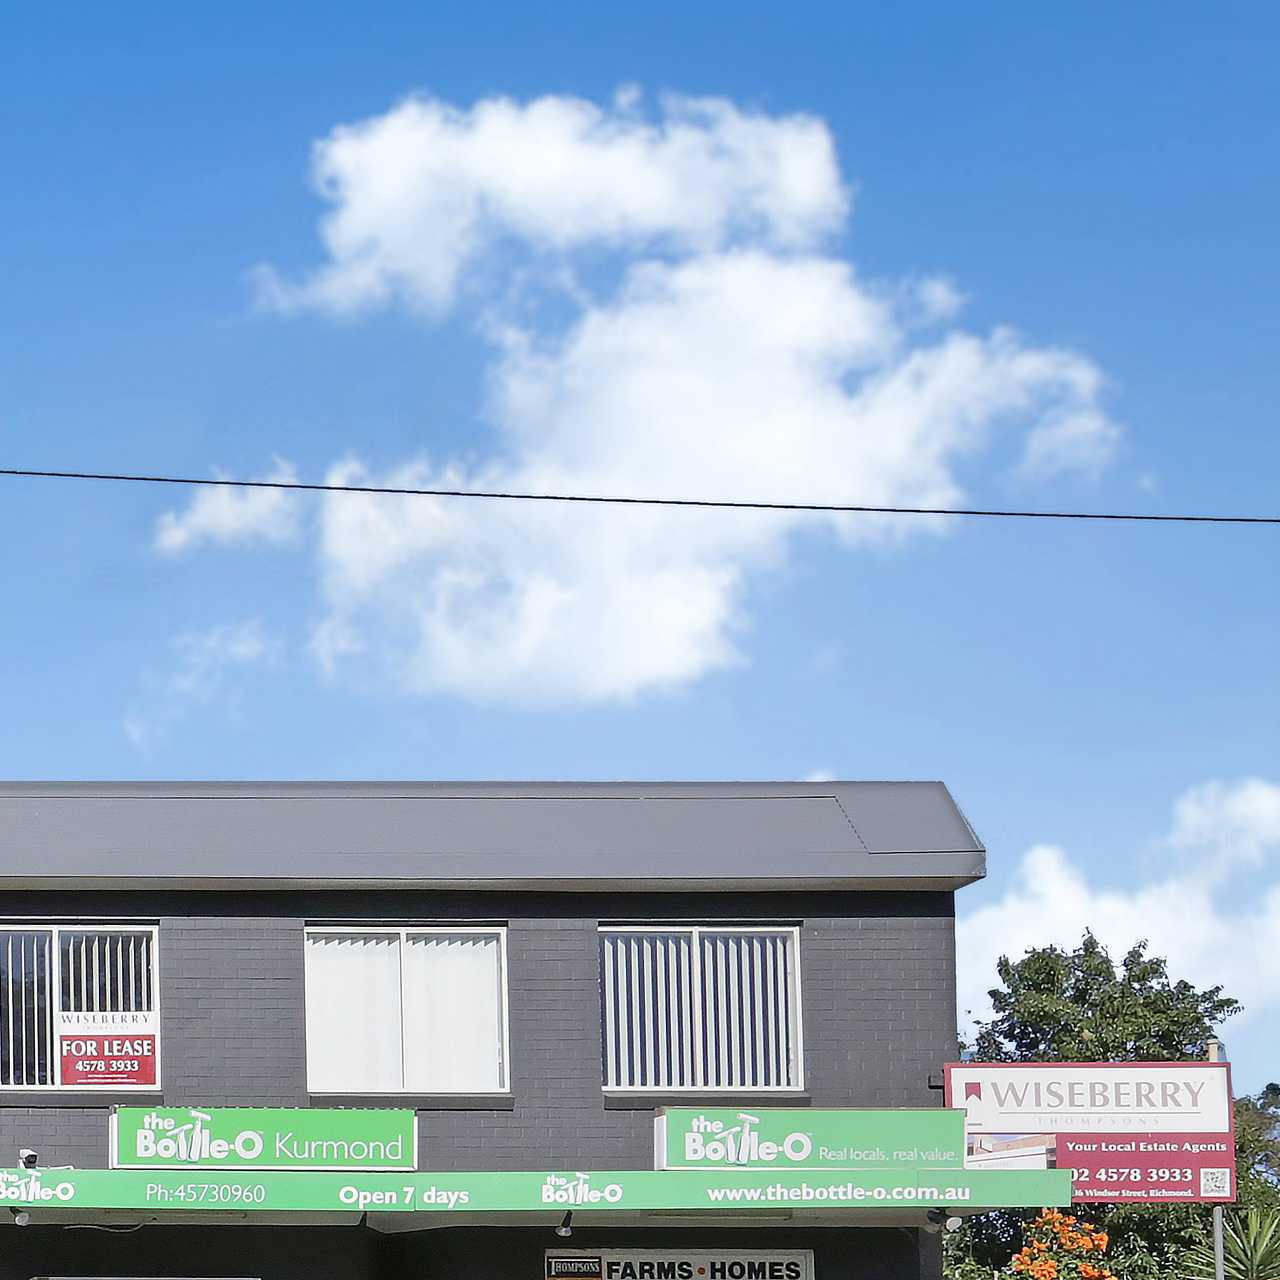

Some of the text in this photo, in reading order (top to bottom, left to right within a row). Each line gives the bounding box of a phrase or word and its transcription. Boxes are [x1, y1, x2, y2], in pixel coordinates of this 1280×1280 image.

[61, 1014, 150, 1024] WISEBERRY
[62, 1040, 152, 1056] FOR LEASE
[75, 1060, 139, 1071] 4578 3933
[991, 1081, 1205, 1109] WISEBERRY
[143, 1112, 176, 1130] the
[692, 1116, 724, 1133] the
[1038, 1116, 1161, 1126] THOMPSONS
[275, 1132, 402, 1160] Kurmond
[819, 1146, 848, 1161] Real
[893, 1146, 917, 1161] real
[1066, 1142, 1227, 1154] Your Local Estate Agents
[546, 1174, 567, 1185] the
[1095, 1168, 1141, 1181] 4578
[1146, 1168, 1193, 1181] 3933
[146, 1183, 266, 1204] Ph:45730960
[338, 1186, 397, 1208] Open
[403, 1187, 415, 1203] 7
[423, 1186, 470, 1209] days
[707, 1183, 971, 1201] www.thebottle-o.com.au
[1085, 1189, 1120, 1197] Windsor
[606, 1261, 694, 1280] FARMS
[710, 1261, 801, 1280] HOMES
